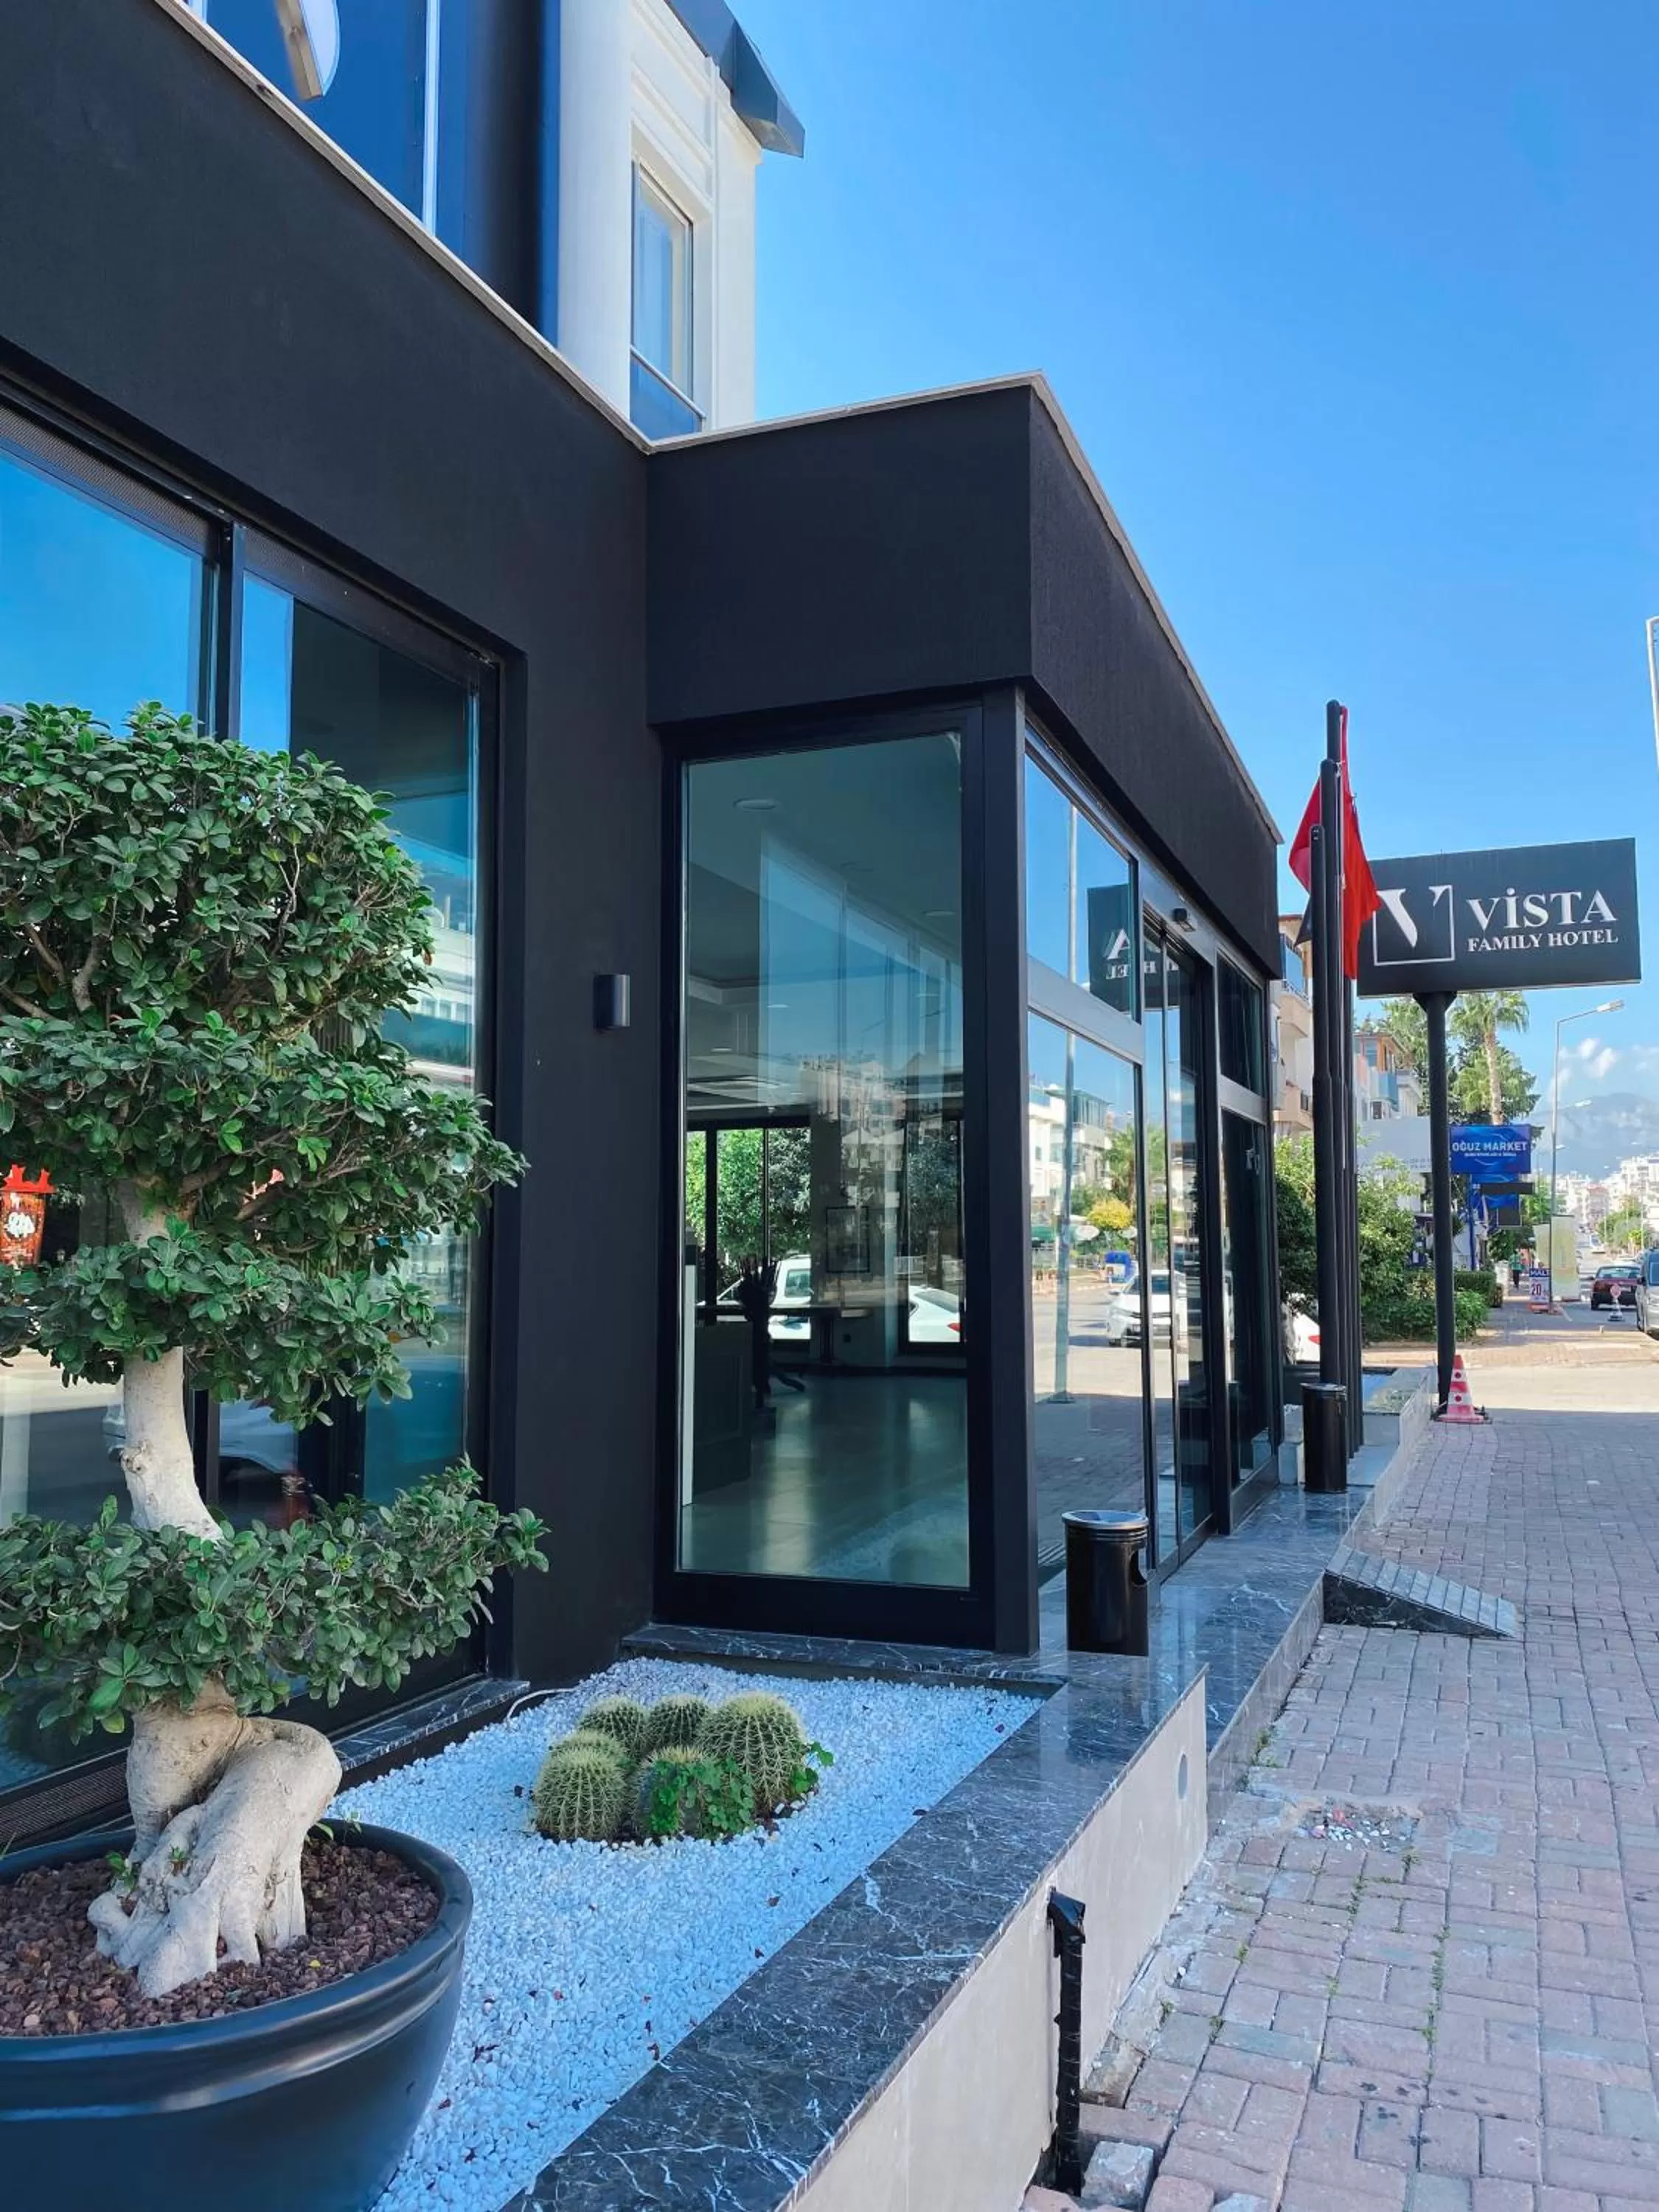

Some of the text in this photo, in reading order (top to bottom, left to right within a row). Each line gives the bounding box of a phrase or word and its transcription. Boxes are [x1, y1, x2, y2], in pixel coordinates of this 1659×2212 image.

[1467, 928, 1618, 952] FAMILY HOTEL
[1483, 1141, 1528, 1151] MARKET
